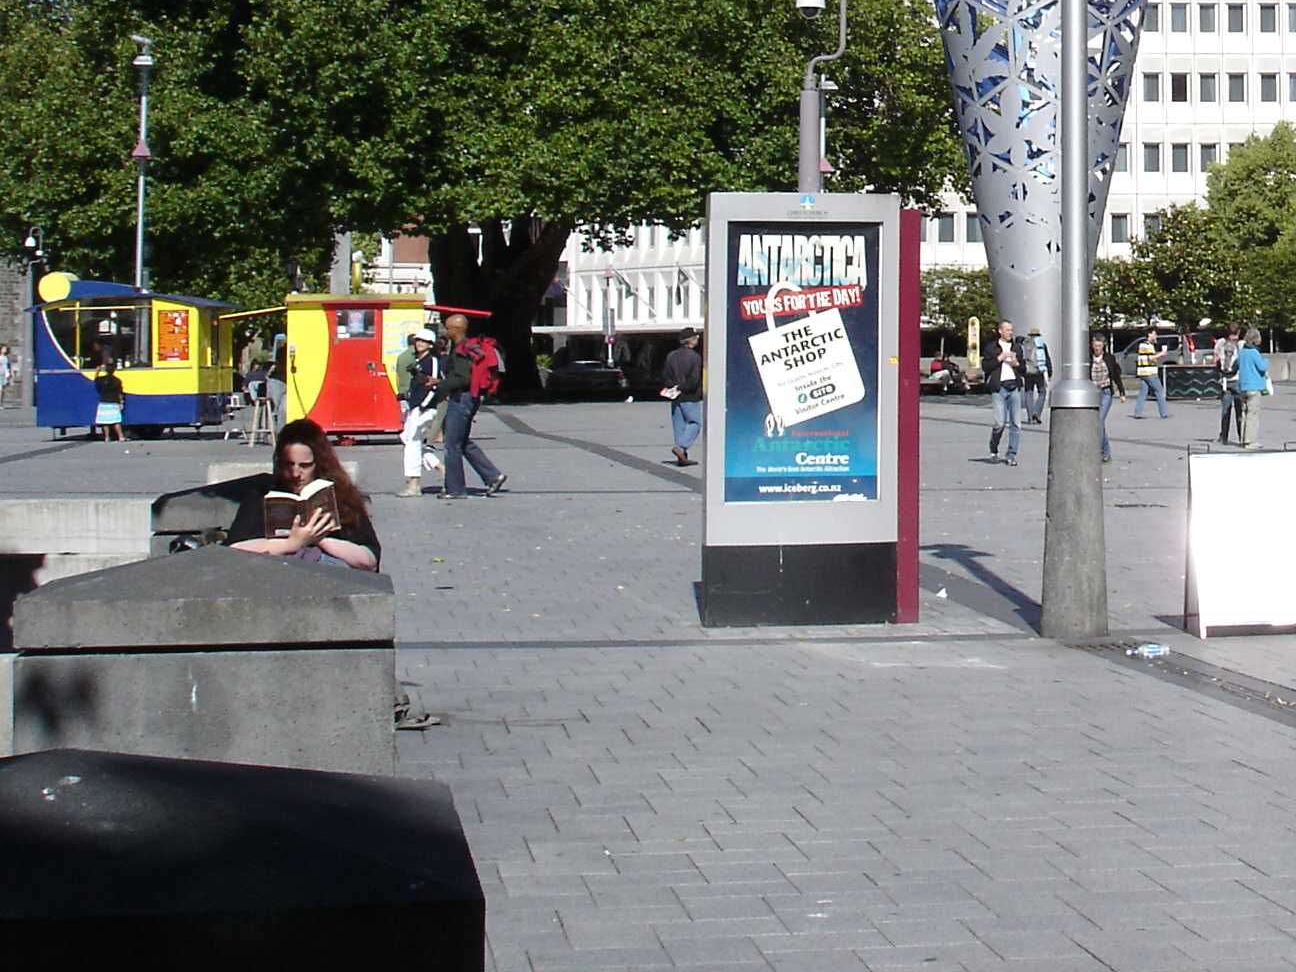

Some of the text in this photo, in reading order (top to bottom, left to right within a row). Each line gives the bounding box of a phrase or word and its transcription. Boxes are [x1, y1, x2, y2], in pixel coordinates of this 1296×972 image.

[737, 234, 867, 287] ANTARCTICA
[783, 293, 808, 311] FOR
[832, 285, 861, 306] DAY!
[782, 325, 813, 343] THE
[761, 328, 844, 366] ANTARCTIC
[784, 348, 826, 371] SHOP
[752, 436, 849, 452] Antarctic
[795, 452, 850, 465] Centre
[758, 483, 842, 495] www.iceberg.co.nz
